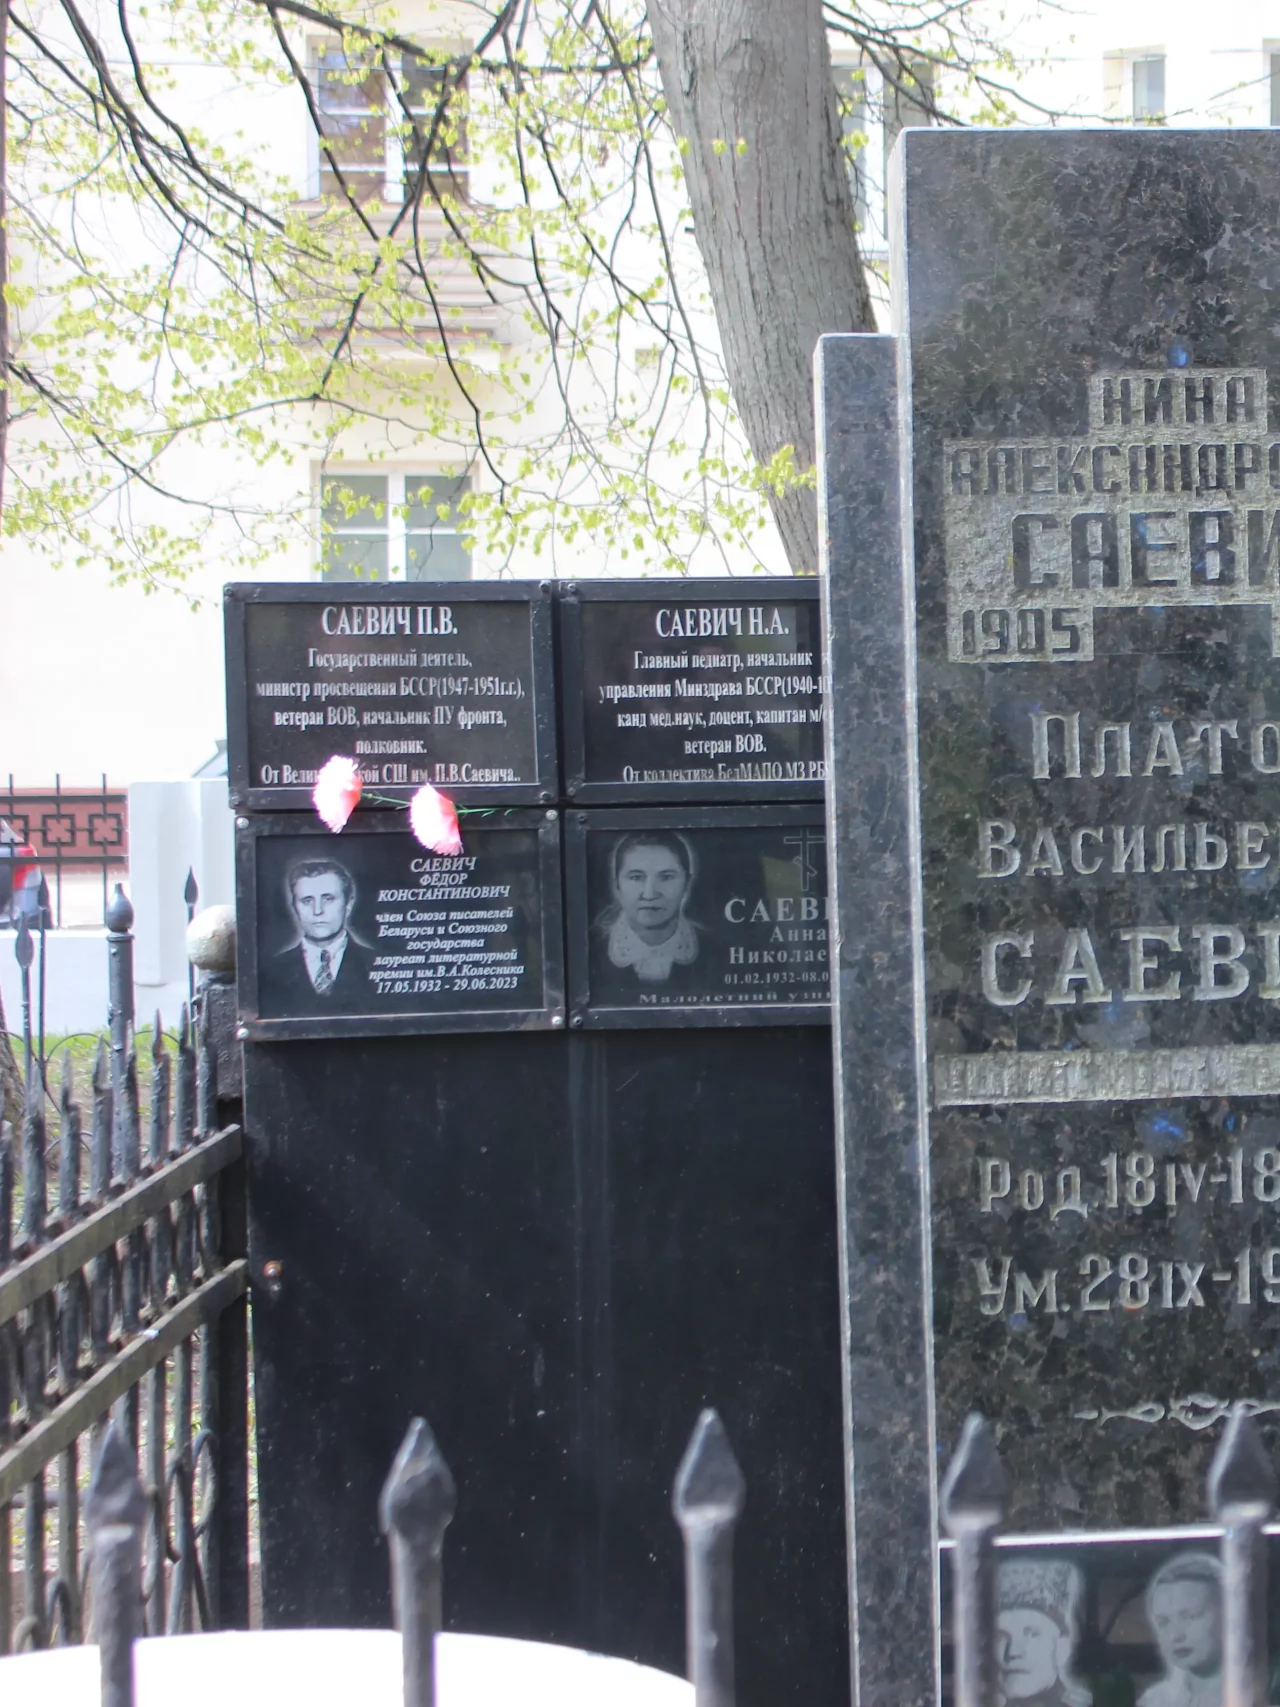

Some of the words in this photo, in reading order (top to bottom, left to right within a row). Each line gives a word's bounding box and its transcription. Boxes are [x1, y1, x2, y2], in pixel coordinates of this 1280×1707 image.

[1102, 376, 1254, 425] НИНА
[321, 606, 413, 635] САЕВИЧ
[417, 606, 458, 635] П.В.
[655, 608, 743, 638] САЕВИЧ
[748, 607, 790, 636] Н.А.
[962, 607, 1081, 655] 1905
[308, 648, 417, 672] Государственный
[420, 651, 473, 669] деятель,
[634, 651, 688, 670] Главный
[692, 653, 744, 673] педиатр,
[746, 652, 813, 668] начальник
[256, 681, 311, 701] министр
[313, 680, 397, 701] просвещения
[599, 683, 671, 704] управления
[675, 678, 743, 702] Минздрава
[274, 710, 324, 731] ветеран
[327, 706, 361, 728] ВОВ,
[363, 709, 432, 725] начальник
[434, 705, 455, 725] ПУ
[458, 706, 507, 730] фронта,
[617, 712, 647, 729] канд
[708, 710, 754, 728] доцент,
[756, 709, 807, 724] капитан
[356, 739, 428, 755] полковник.
[684, 739, 732, 759] ветеран
[735, 734, 767, 754] ВОВ.
[261, 764, 280, 784] От
[382, 763, 408, 783] СШ
[623, 765, 640, 783] От
[786, 762, 806, 780] МЗ
[410, 856, 477, 872] САЕВИЧ
[377, 885, 511, 902] КОНСТАНТИНОВИЧ
[375, 911, 404, 923] член
[407, 909, 447, 923] Союза
[449, 906, 514, 920] писателей
[378, 924, 435, 939] Беларуси
[437, 923, 446, 932] и
[448, 922, 508, 935] Союзного
[770, 925, 827, 942] Анна
[406, 937, 485, 953] государства
[373, 955, 426, 968] лауреат
[428, 949, 518, 966] литературной
[729, 947, 827, 965] Николае
[368, 969, 414, 983] премии
[376, 979, 442, 994] 17.05.1932
[453, 976, 518, 992] 29.06.2023
